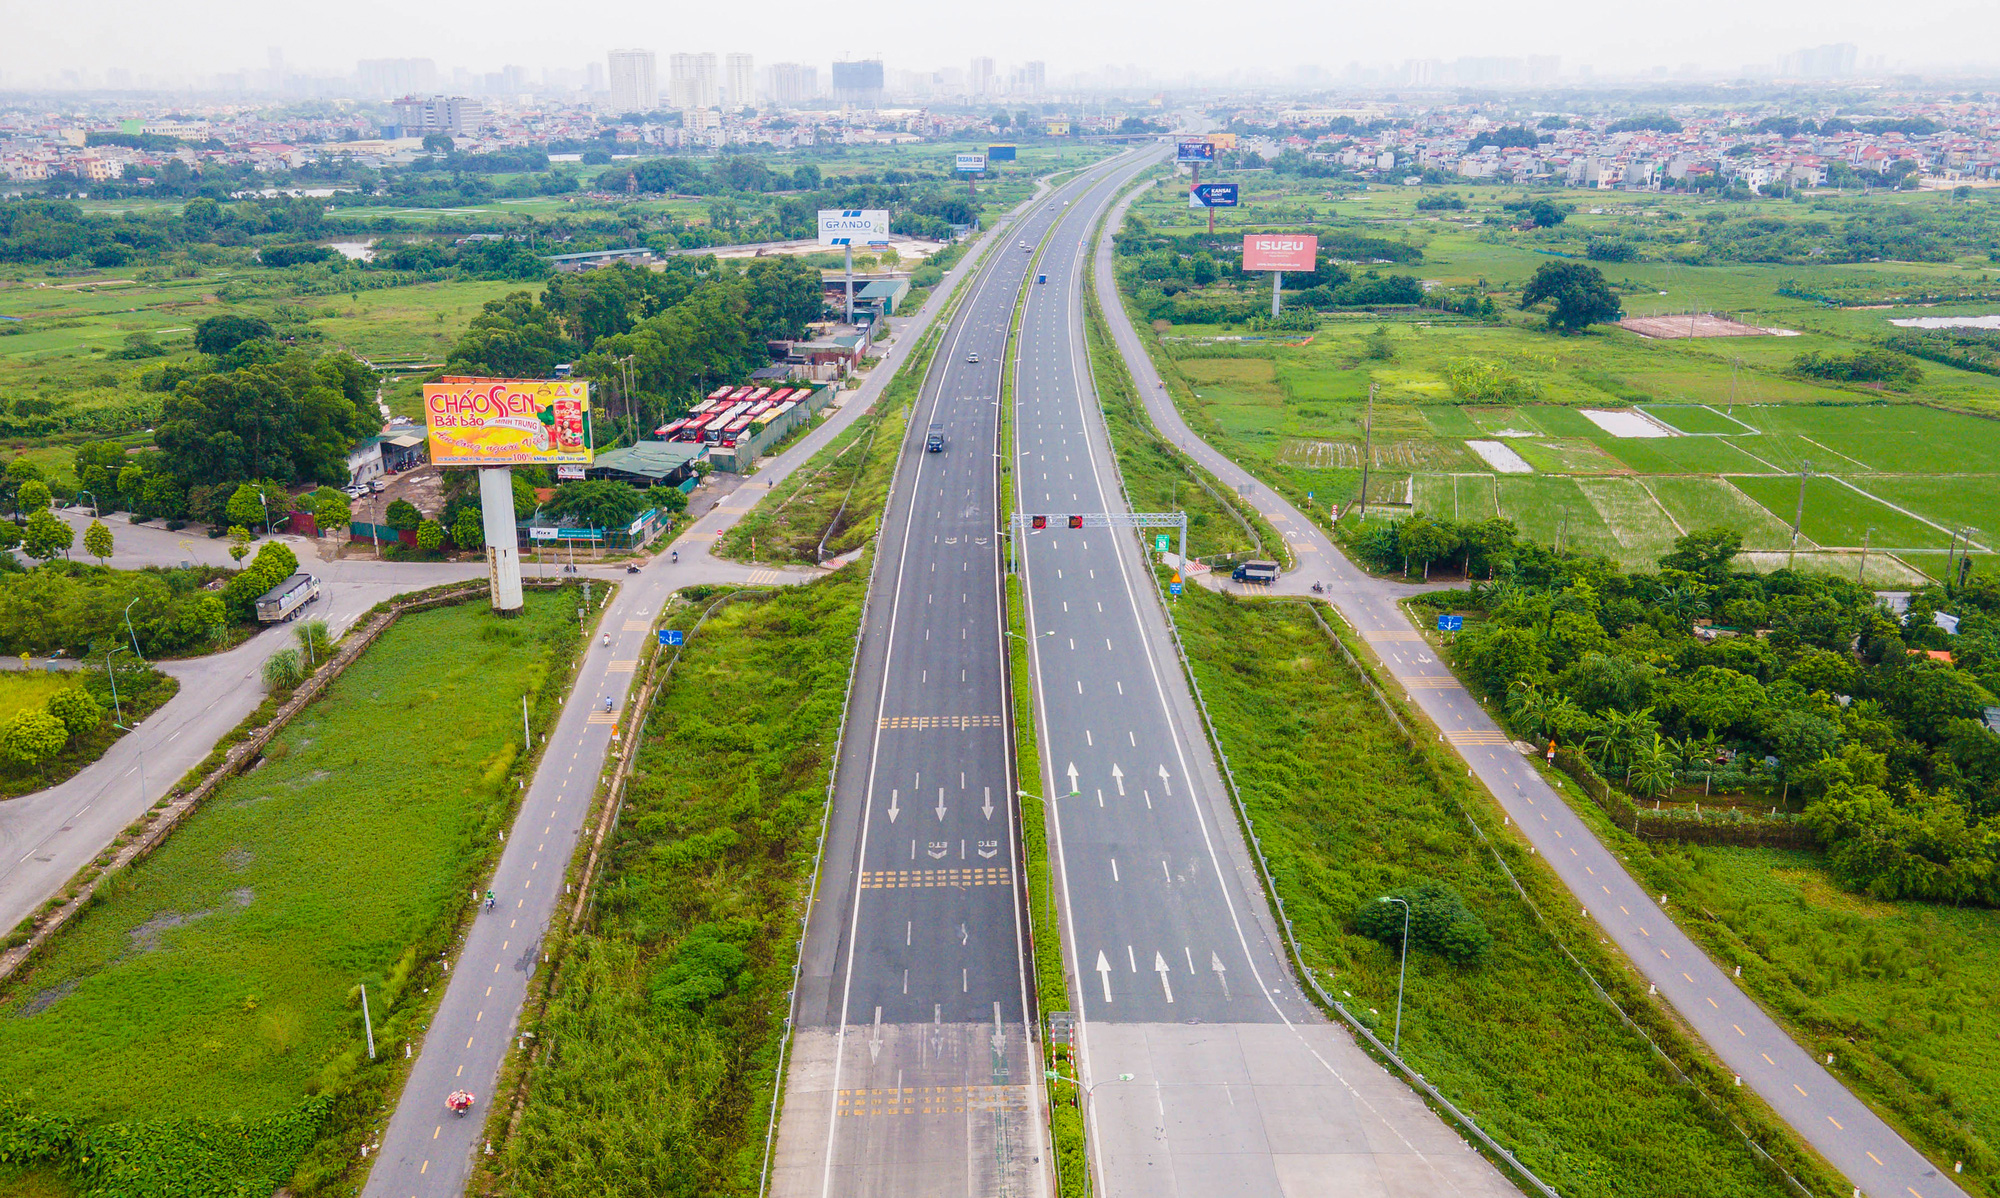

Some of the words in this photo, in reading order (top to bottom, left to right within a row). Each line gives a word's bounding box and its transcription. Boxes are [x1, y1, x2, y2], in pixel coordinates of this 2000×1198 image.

[825, 220, 871, 229] GRANDO
[1256, 241, 1304, 250] ISUZU
[429, 389, 490, 414] CHÁO
[489, 385, 535, 418] SEN
[434, 414, 457, 427] Bát
[460, 413, 484, 427] bảo
[514, 419, 538, 430] TRUNG
